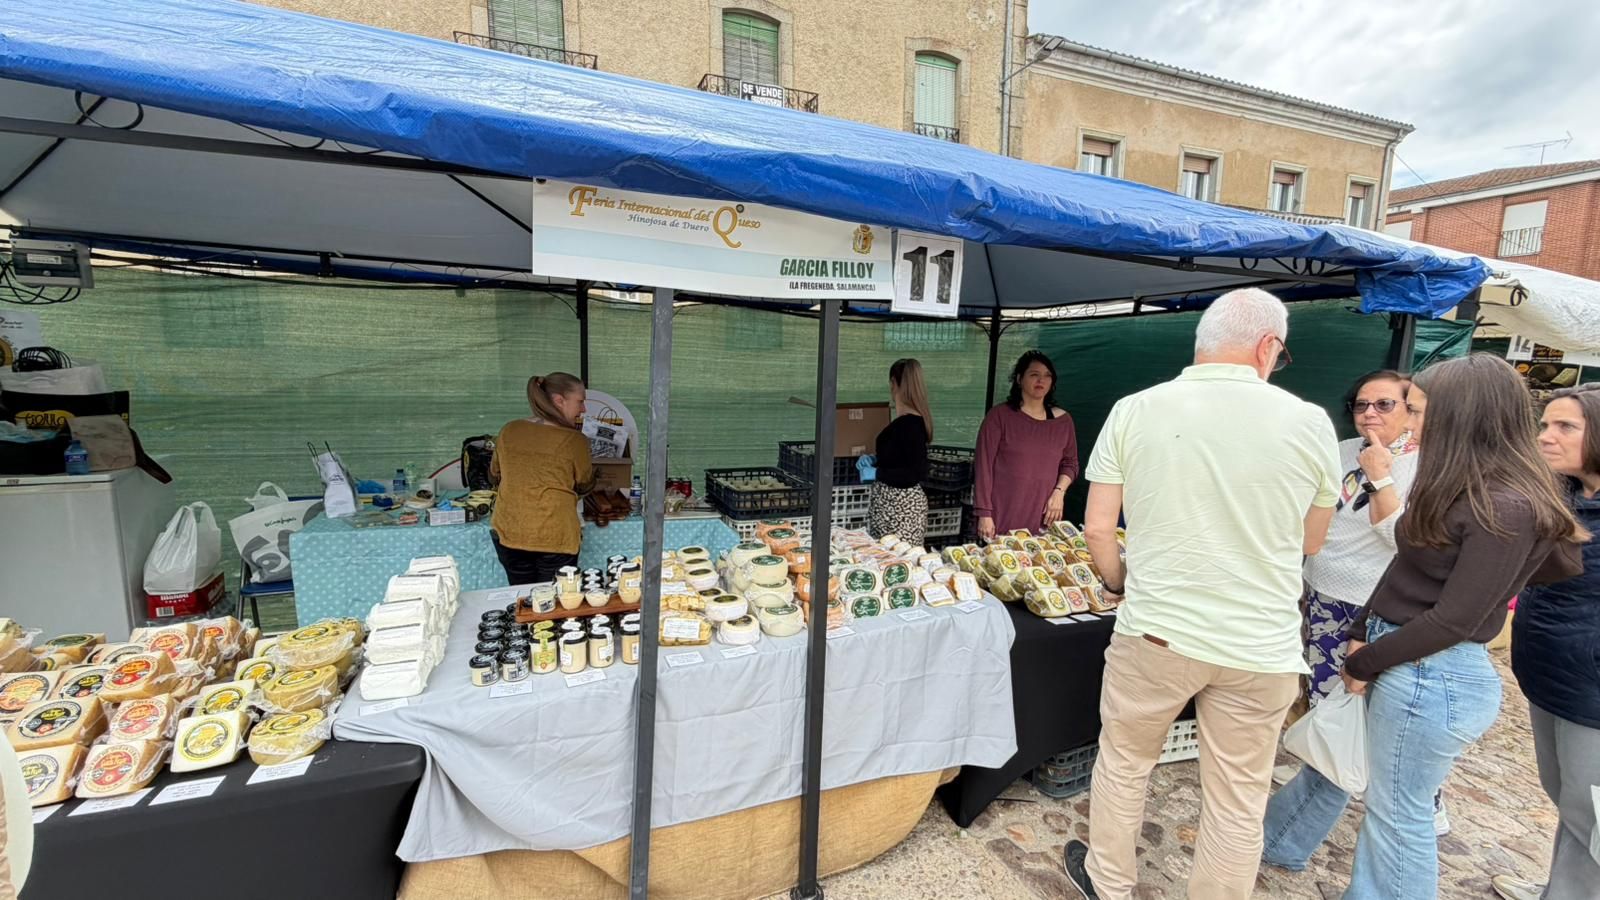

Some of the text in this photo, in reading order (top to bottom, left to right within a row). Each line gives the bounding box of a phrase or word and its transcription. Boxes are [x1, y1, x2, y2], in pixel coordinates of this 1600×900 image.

[743, 83, 782, 98] SE VENDE
[568, 185, 761, 248] Feria Internacional del Queso
[627, 213, 710, 232] Hinojosa de Duero
[779, 258, 875, 279] GARCIA FILLOY
[903, 246, 955, 304] 11
[789, 281, 799, 290] (LA
[836, 283, 876, 292] SALAMANCA)
